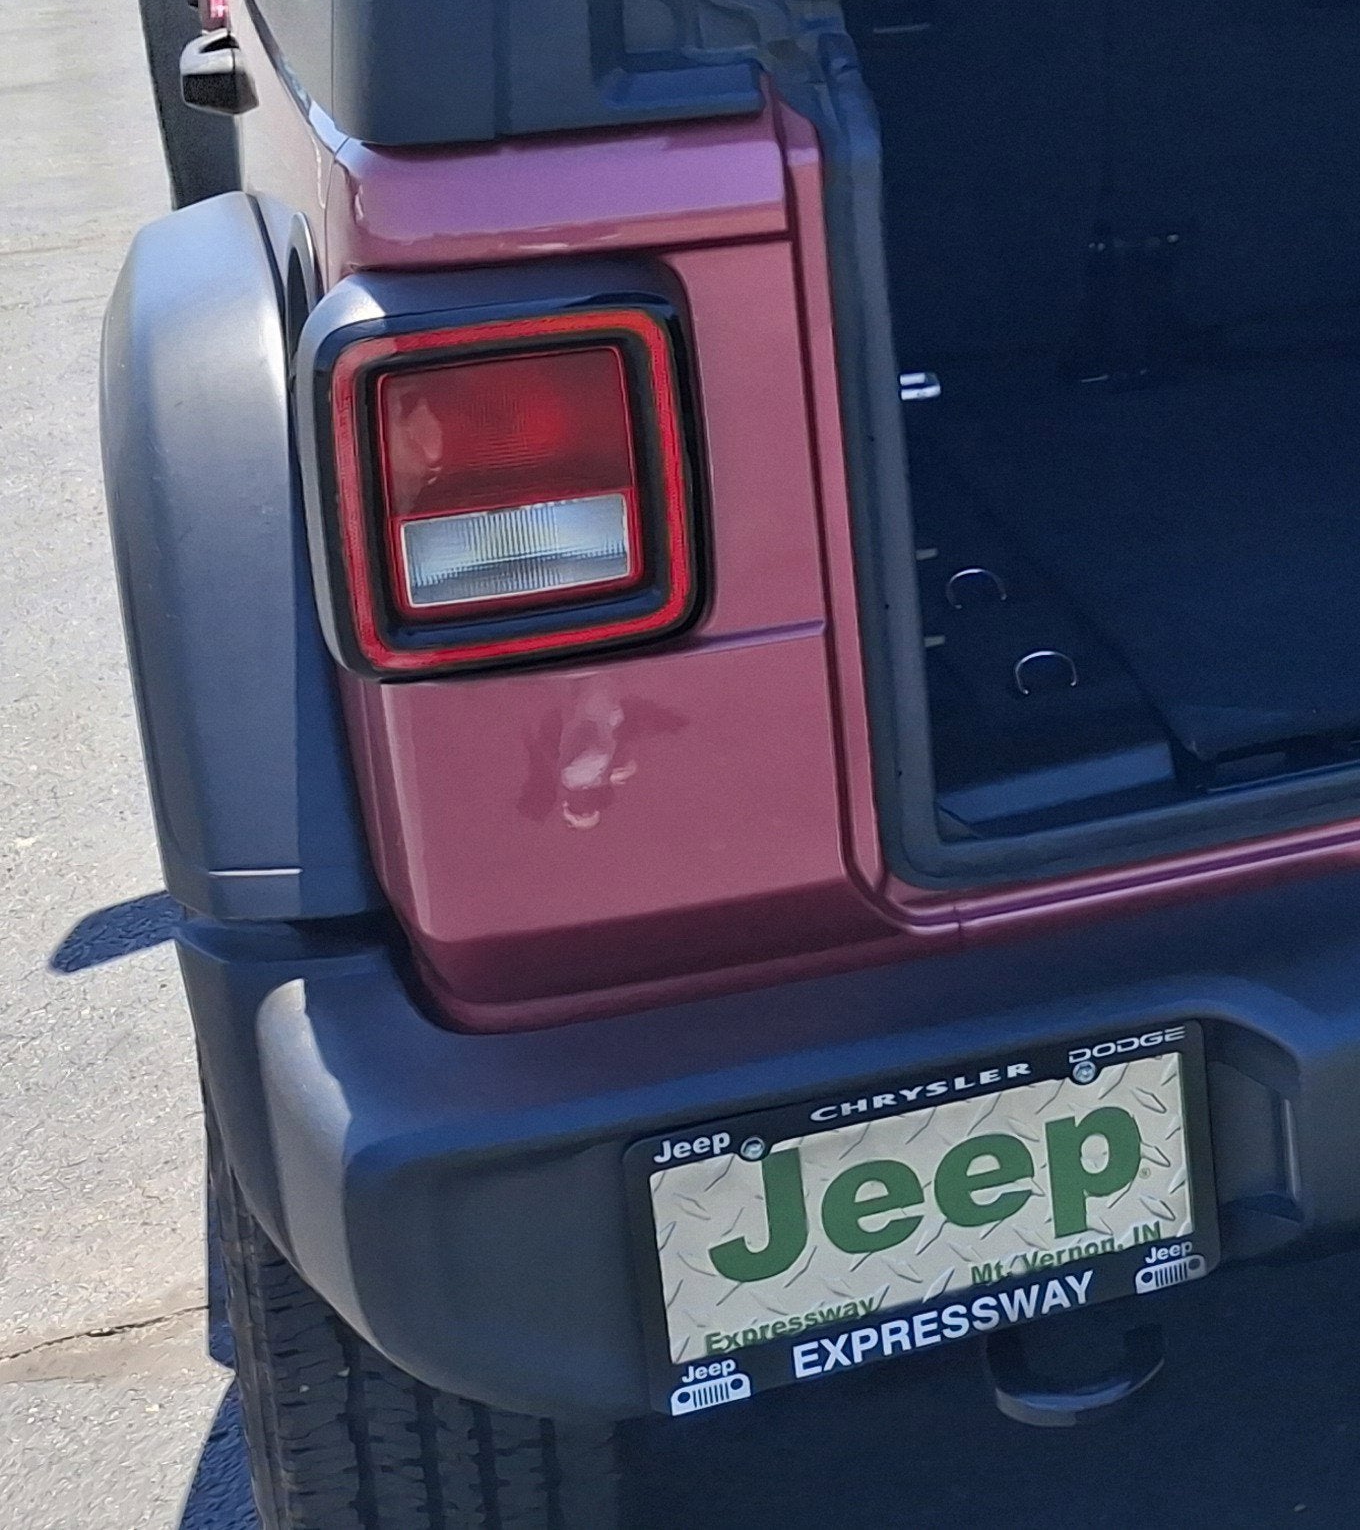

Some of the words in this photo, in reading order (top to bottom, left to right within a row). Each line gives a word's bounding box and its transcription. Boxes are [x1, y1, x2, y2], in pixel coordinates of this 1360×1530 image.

[1068, 1026, 1185, 1063] DODGE
[810, 1062, 1031, 1122] CHRYSLER
[653, 1132, 731, 1163] Jeep
[708, 1106, 1141, 1283] Jeep
[971, 1263, 1011, 1285] Mt.
[1132, 1220, 1162, 1243] IN
[1145, 1240, 1193, 1264] Jeep
[704, 1296, 876, 1356] Expressway
[792, 1270, 1095, 1378] EXPRESSWAY
[682, 1359, 737, 1384] Jeep
